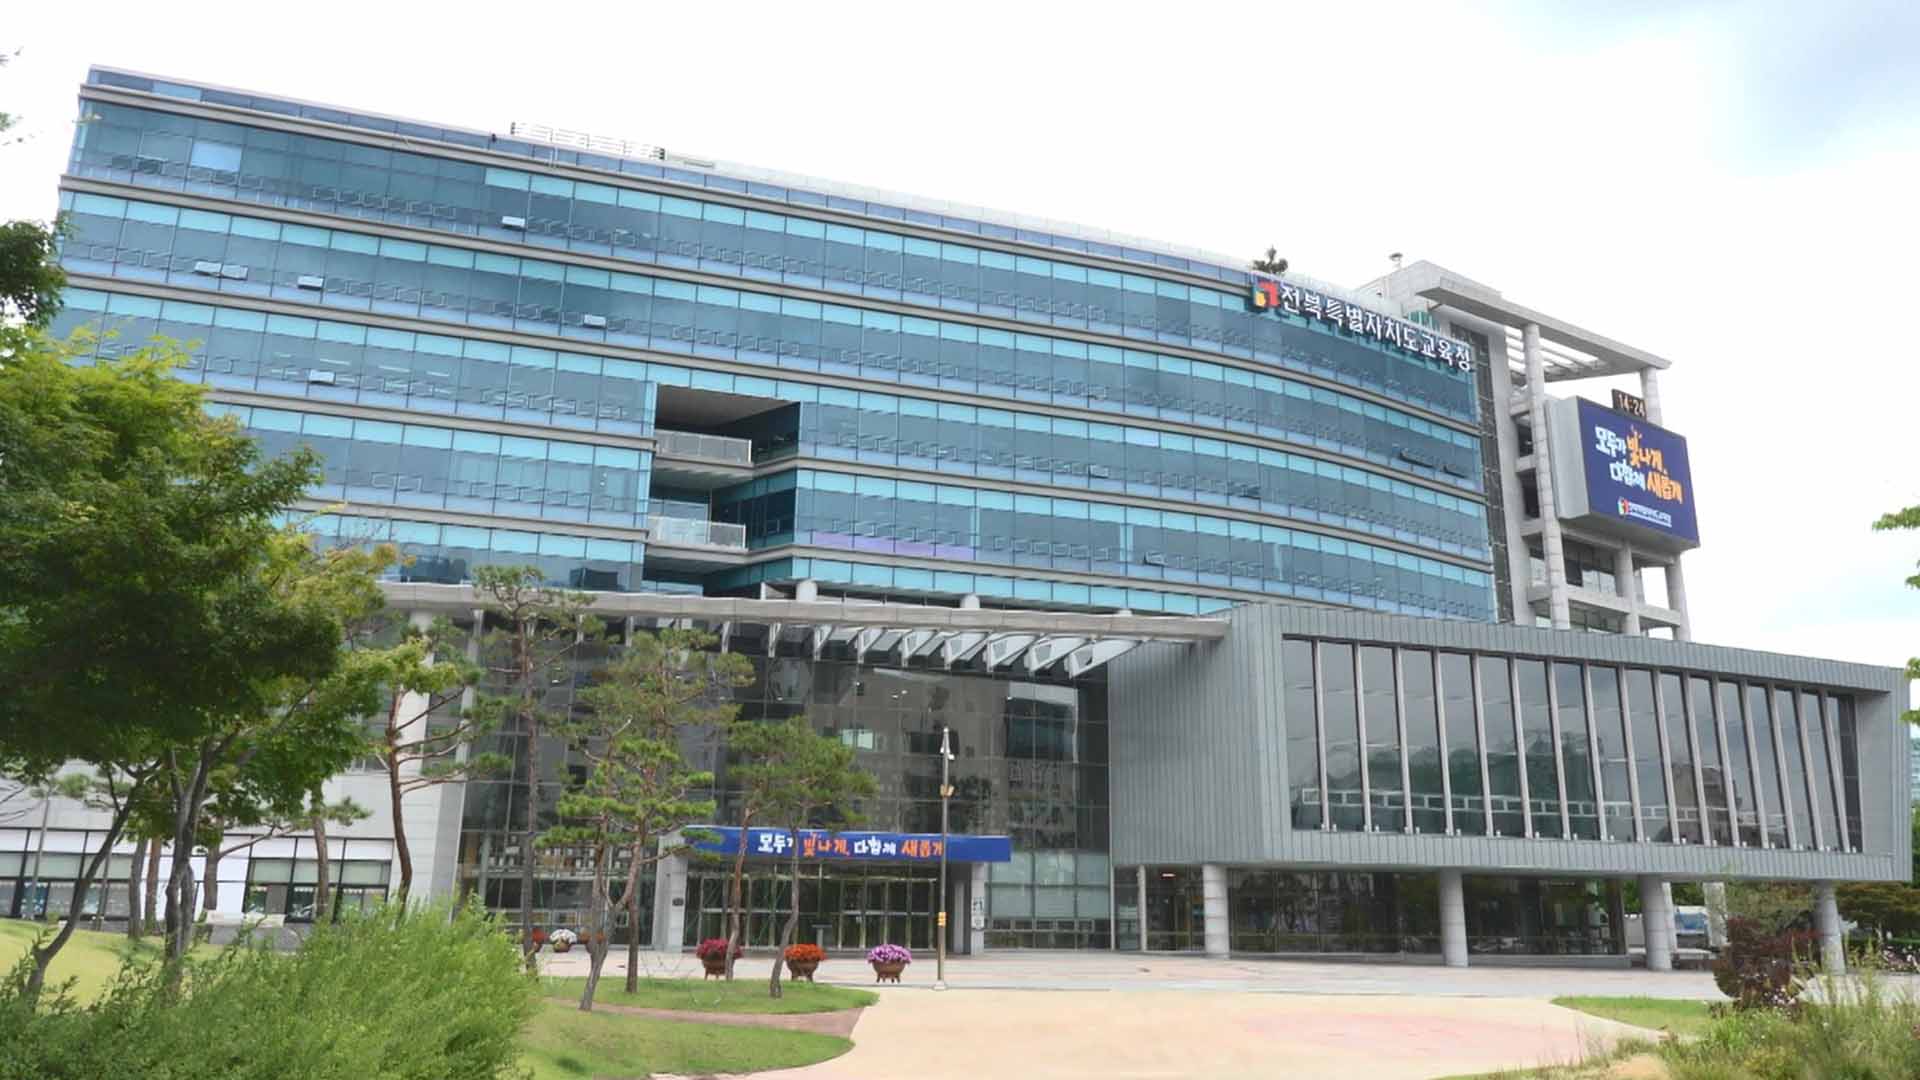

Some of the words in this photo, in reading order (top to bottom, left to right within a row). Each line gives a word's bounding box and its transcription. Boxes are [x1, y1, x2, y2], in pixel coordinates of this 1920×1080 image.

[1280, 283, 1471, 371] 전북특별자치도교육청
[1594, 426, 1627, 458] 모두가
[1608, 459, 1646, 492] 다함께
[1646, 471, 1684, 504] 새롭게
[853, 835, 897, 856] 다함께
